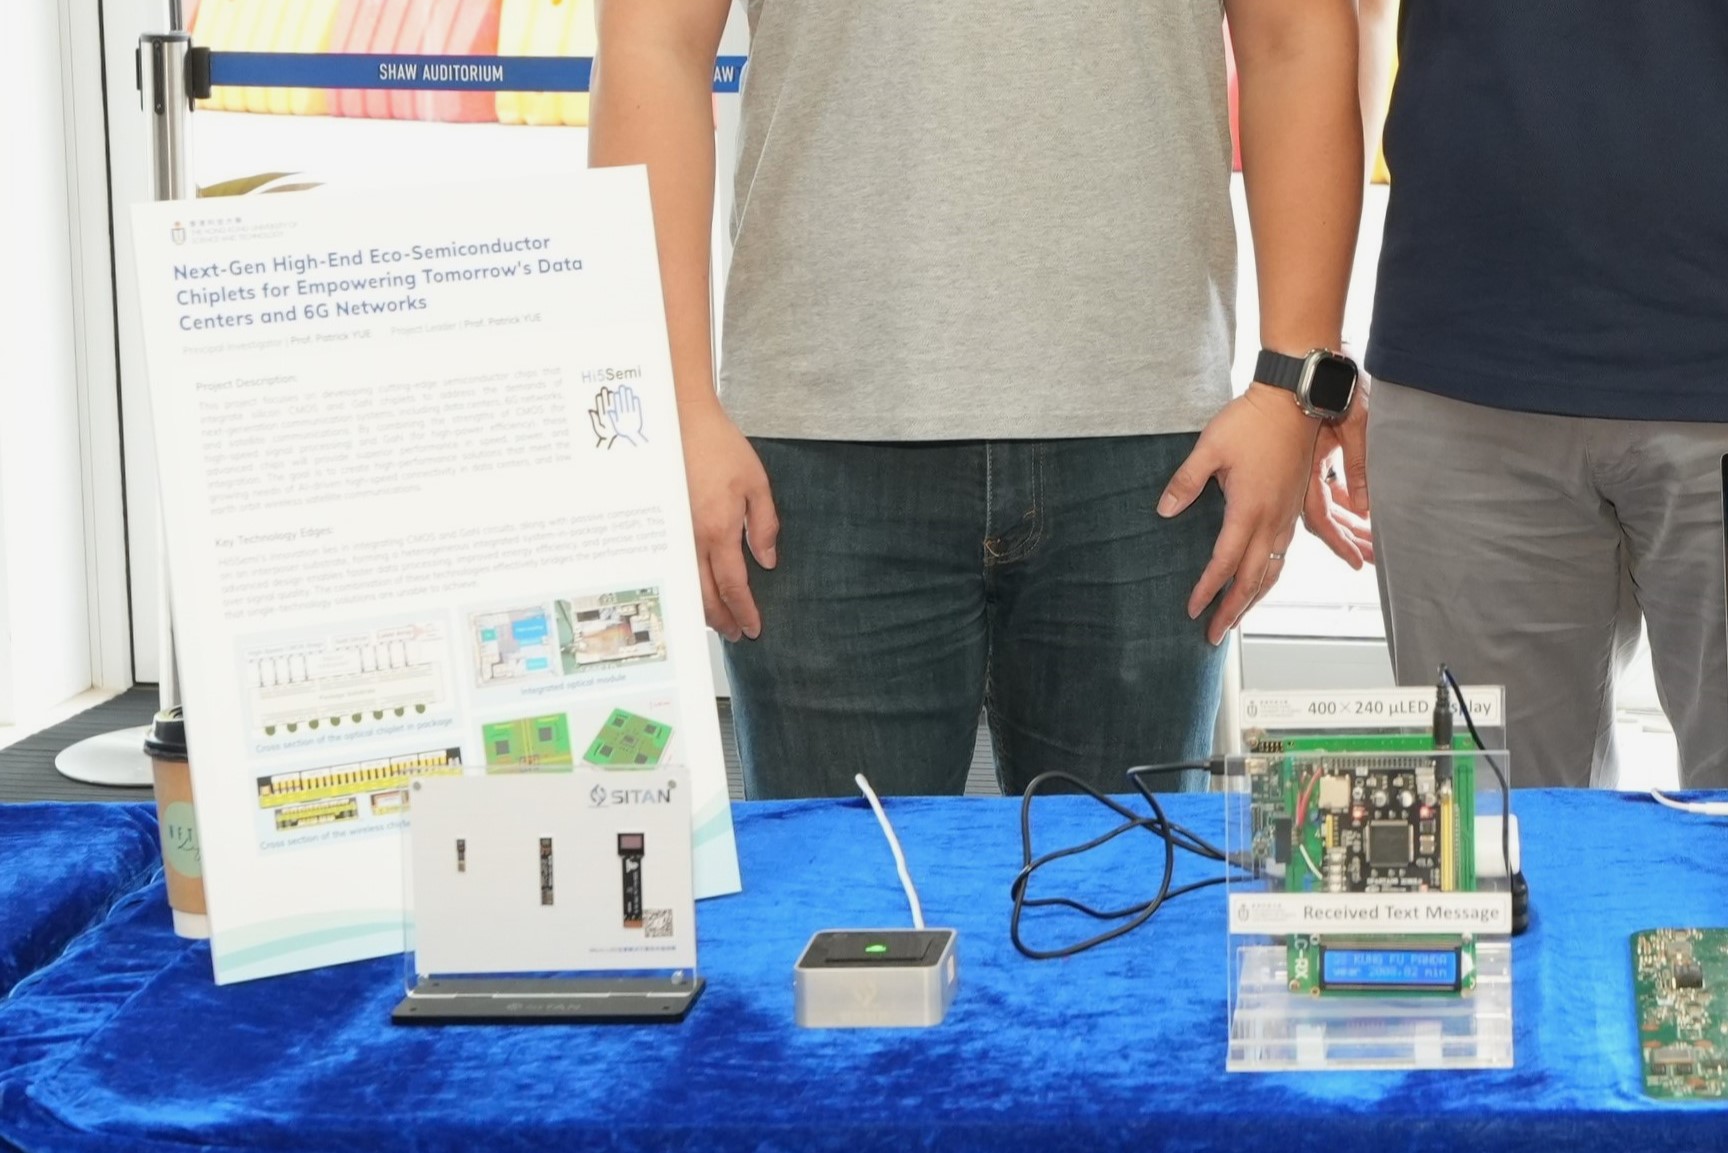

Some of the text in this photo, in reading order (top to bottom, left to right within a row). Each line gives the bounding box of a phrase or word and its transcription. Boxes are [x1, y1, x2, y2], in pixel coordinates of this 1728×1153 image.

[379, 63, 504, 82] SHAW AUDITORIUM
[713, 65, 734, 83] AW
[172, 233, 552, 281] Next-Gen High-End Eco-Semiconductor
[175, 255, 584, 309] Chiplets for Empowering Tomorrow's Data
[178, 293, 428, 332] Centers and 6G Networks
[194, 372, 298, 393] Project Description:
[580, 365, 642, 385] Hi5Semi
[213, 524, 334, 550] Key Technology Edges:
[611, 788, 671, 804] SITAN
[385, 817, 411, 832] chiple
[1303, 905, 1379, 920] Received
[1385, 905, 1419, 920] Text
[1426, 905, 1500, 923] Message
[1294, 934, 1309, 979] C-RX
